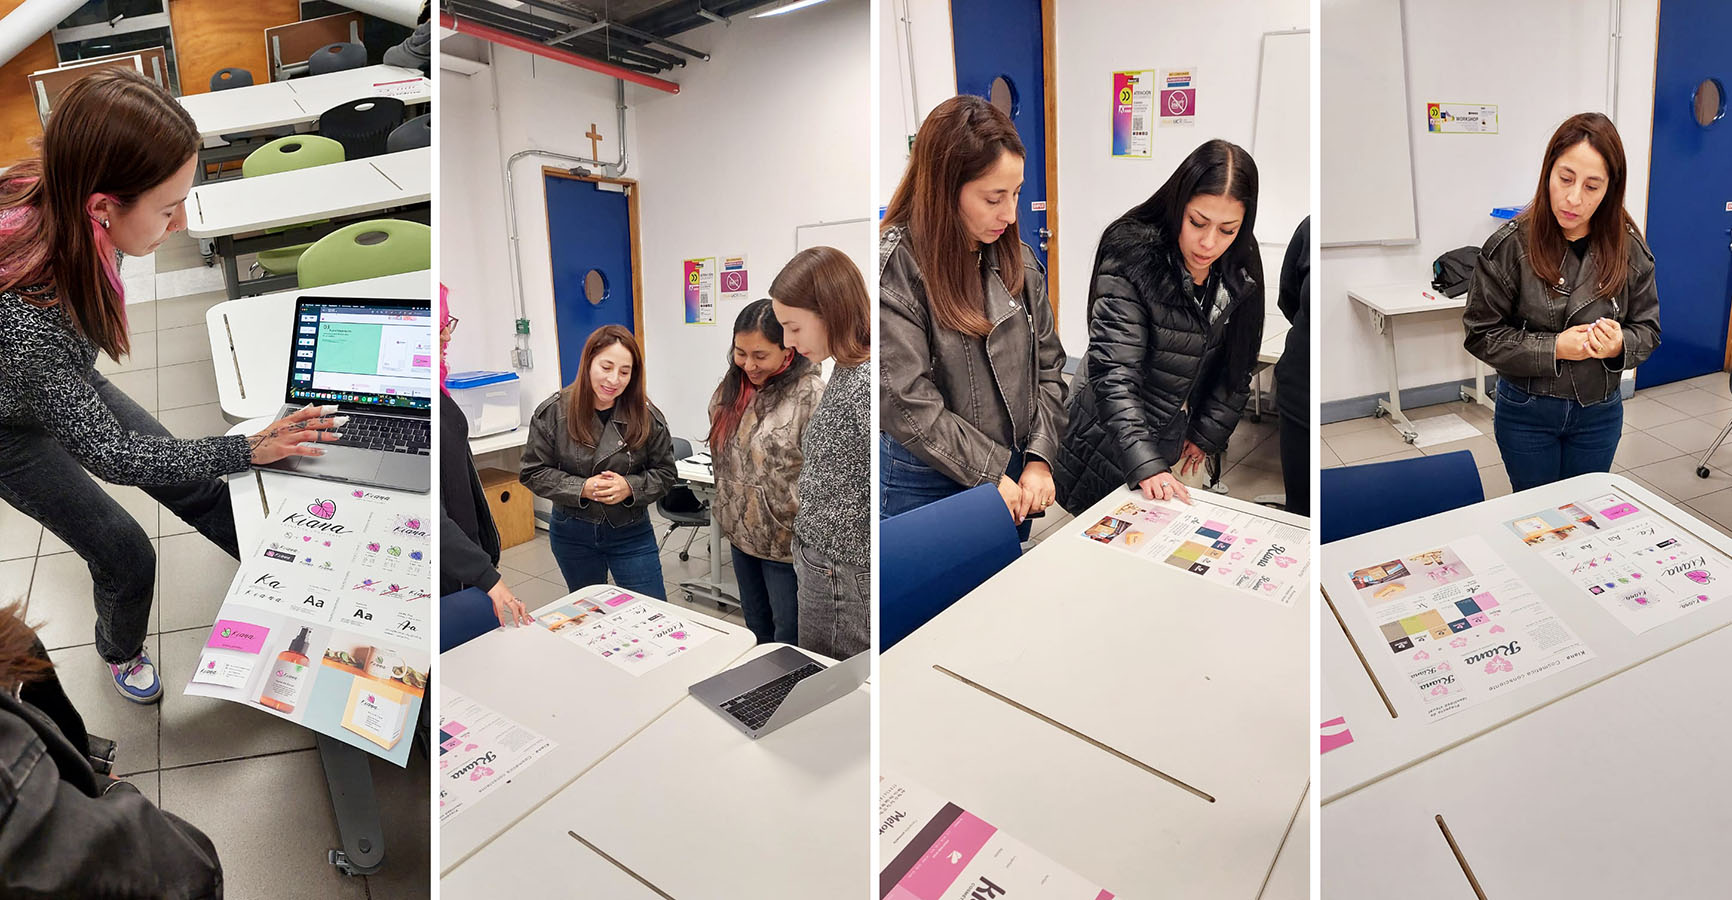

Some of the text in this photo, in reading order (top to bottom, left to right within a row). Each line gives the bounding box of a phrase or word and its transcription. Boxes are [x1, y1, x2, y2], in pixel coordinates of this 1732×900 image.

[283, 512, 353, 535] Kiana
[1257, 543, 1286, 568] Kiana
[1661, 556, 1706, 577] Kiana
[254, 573, 287, 589] Ka
[303, 594, 325, 608] Aa
[353, 608, 374, 621] Aa
[652, 621, 684, 639] Kiana
[1464, 640, 1521, 665] Kiana
[1419, 674, 1456, 690] Kiana
[450, 751, 497, 780] Kiana
